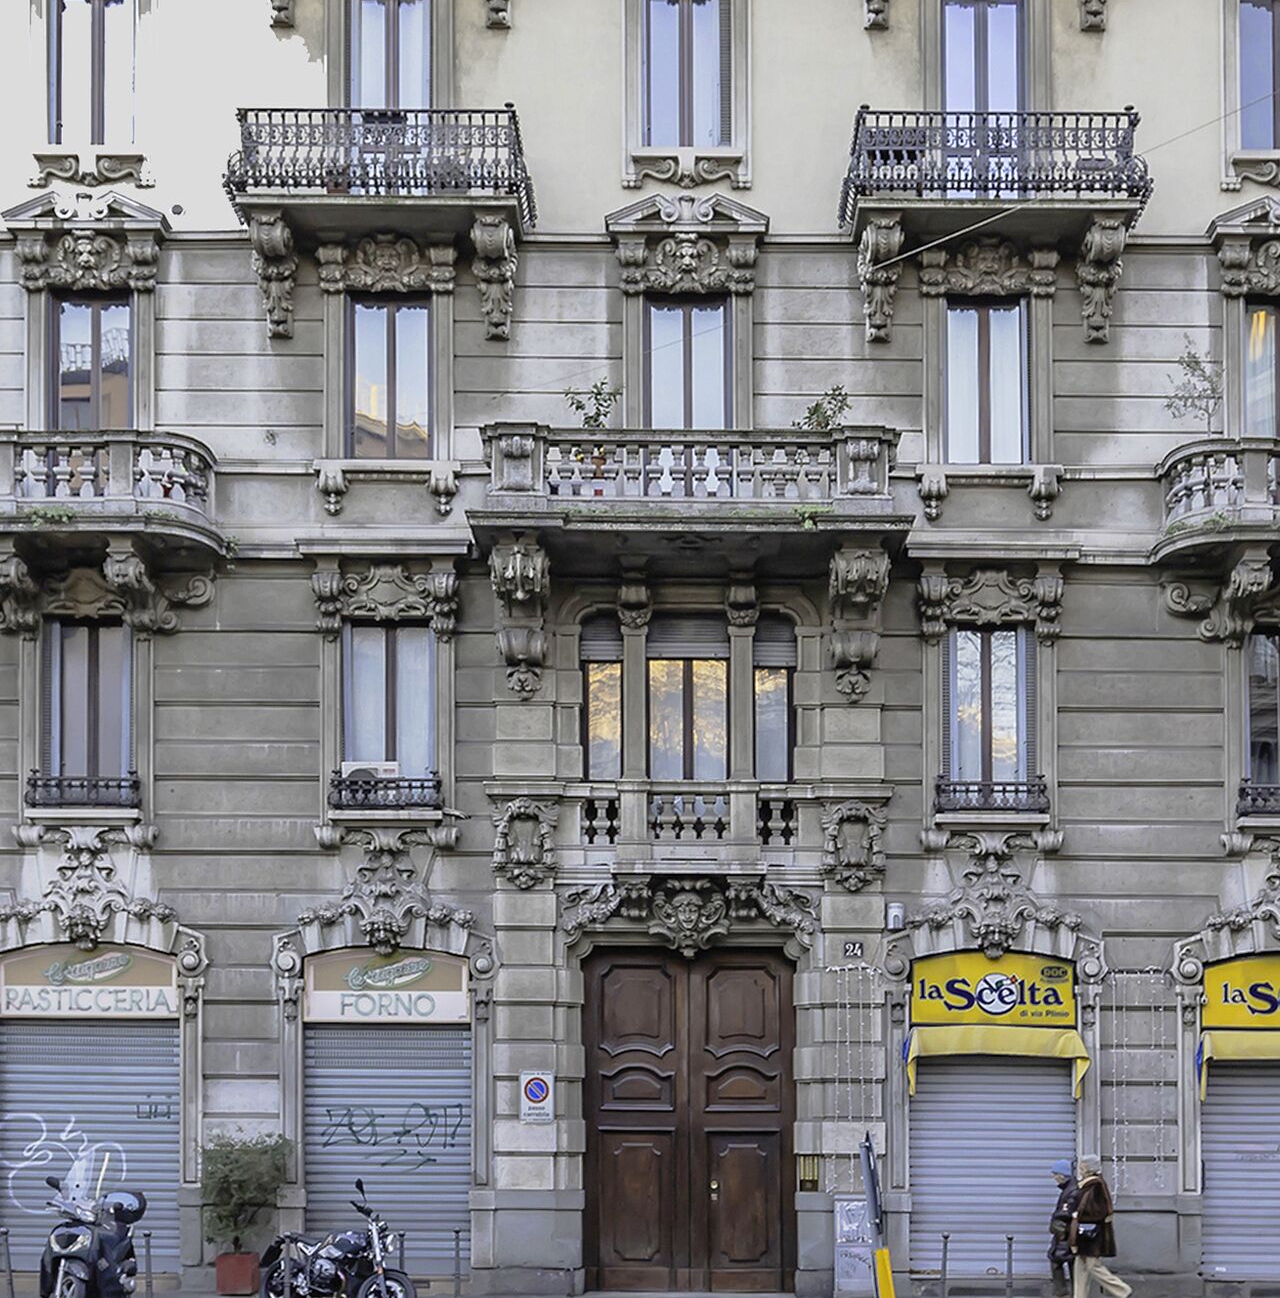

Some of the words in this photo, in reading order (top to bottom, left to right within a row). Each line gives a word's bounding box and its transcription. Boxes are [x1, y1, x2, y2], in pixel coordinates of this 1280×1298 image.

[845, 943, 862, 956] 24
[5, 988, 177, 1014] PASTICCERIA
[340, 993, 436, 1017] FORNO
